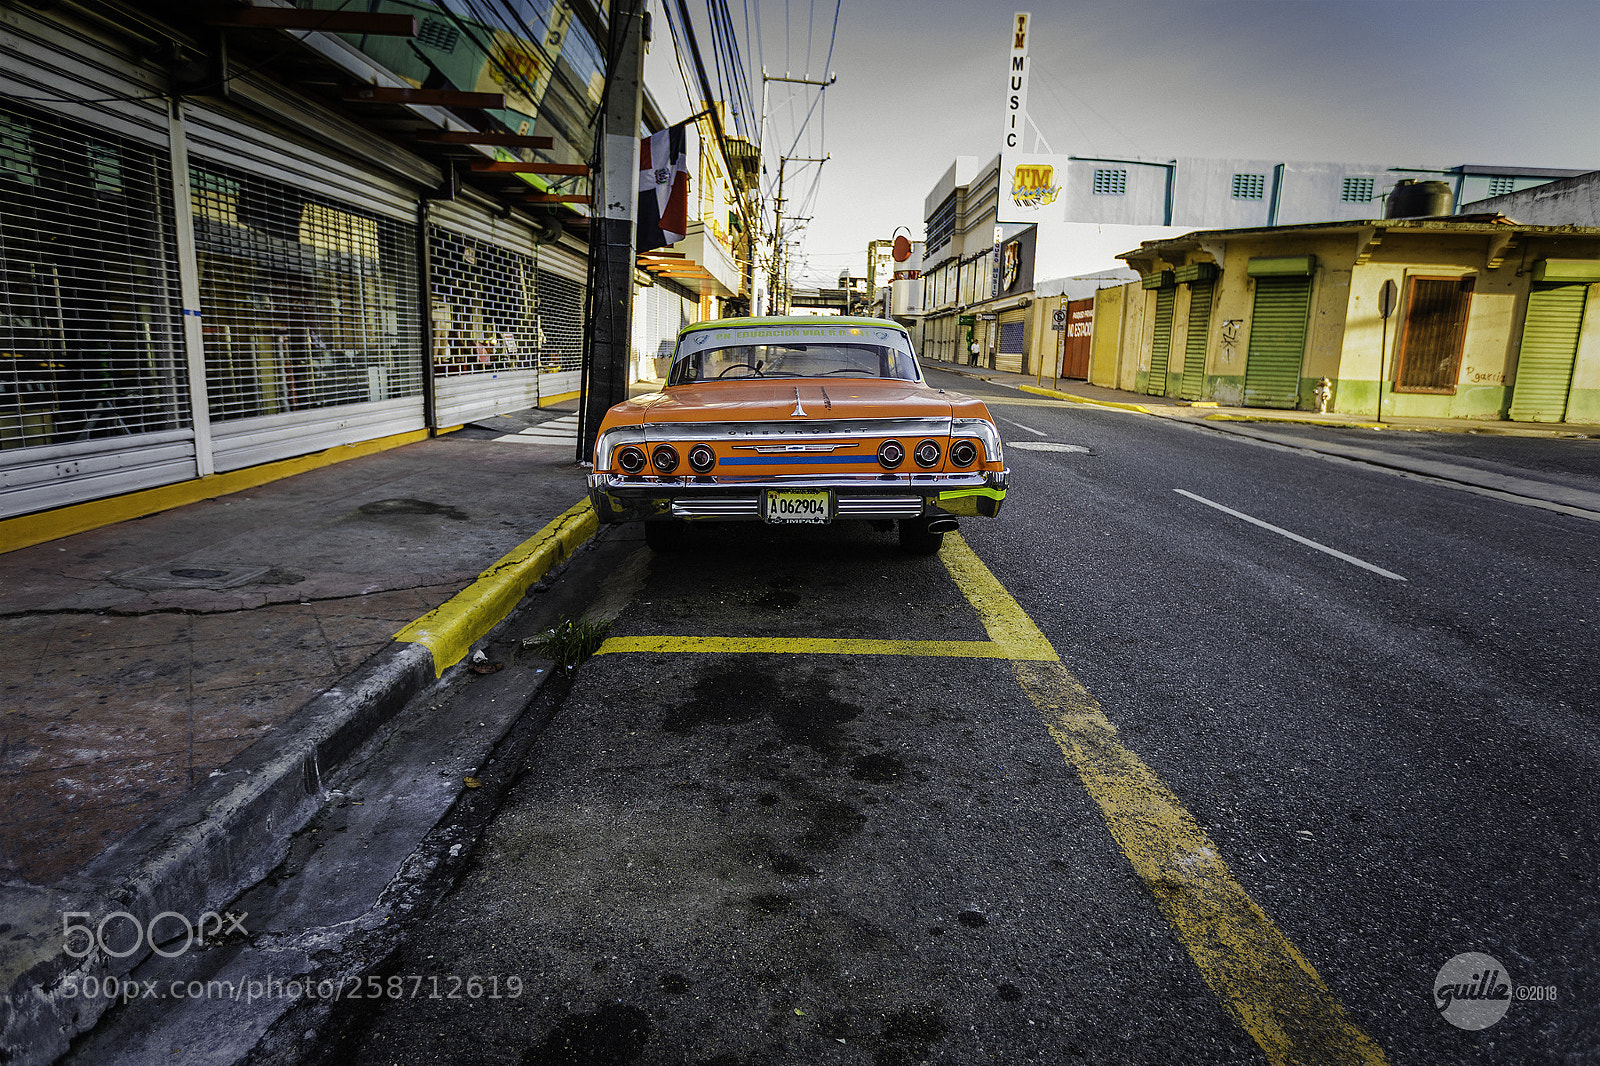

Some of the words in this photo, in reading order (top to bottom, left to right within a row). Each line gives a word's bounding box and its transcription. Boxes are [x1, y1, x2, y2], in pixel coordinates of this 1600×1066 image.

[1014, 16, 1025, 48] TM
[1006, 56, 1024, 147] MUSIC
[1016, 168, 1052, 190] TM
[736, 329, 800, 338] EDUCACION
[1067, 323, 1075, 338] NO
[728, 427, 868, 436] CHEVROLET
[770, 499, 777, 514] A
[780, 498, 824, 514] 062904
